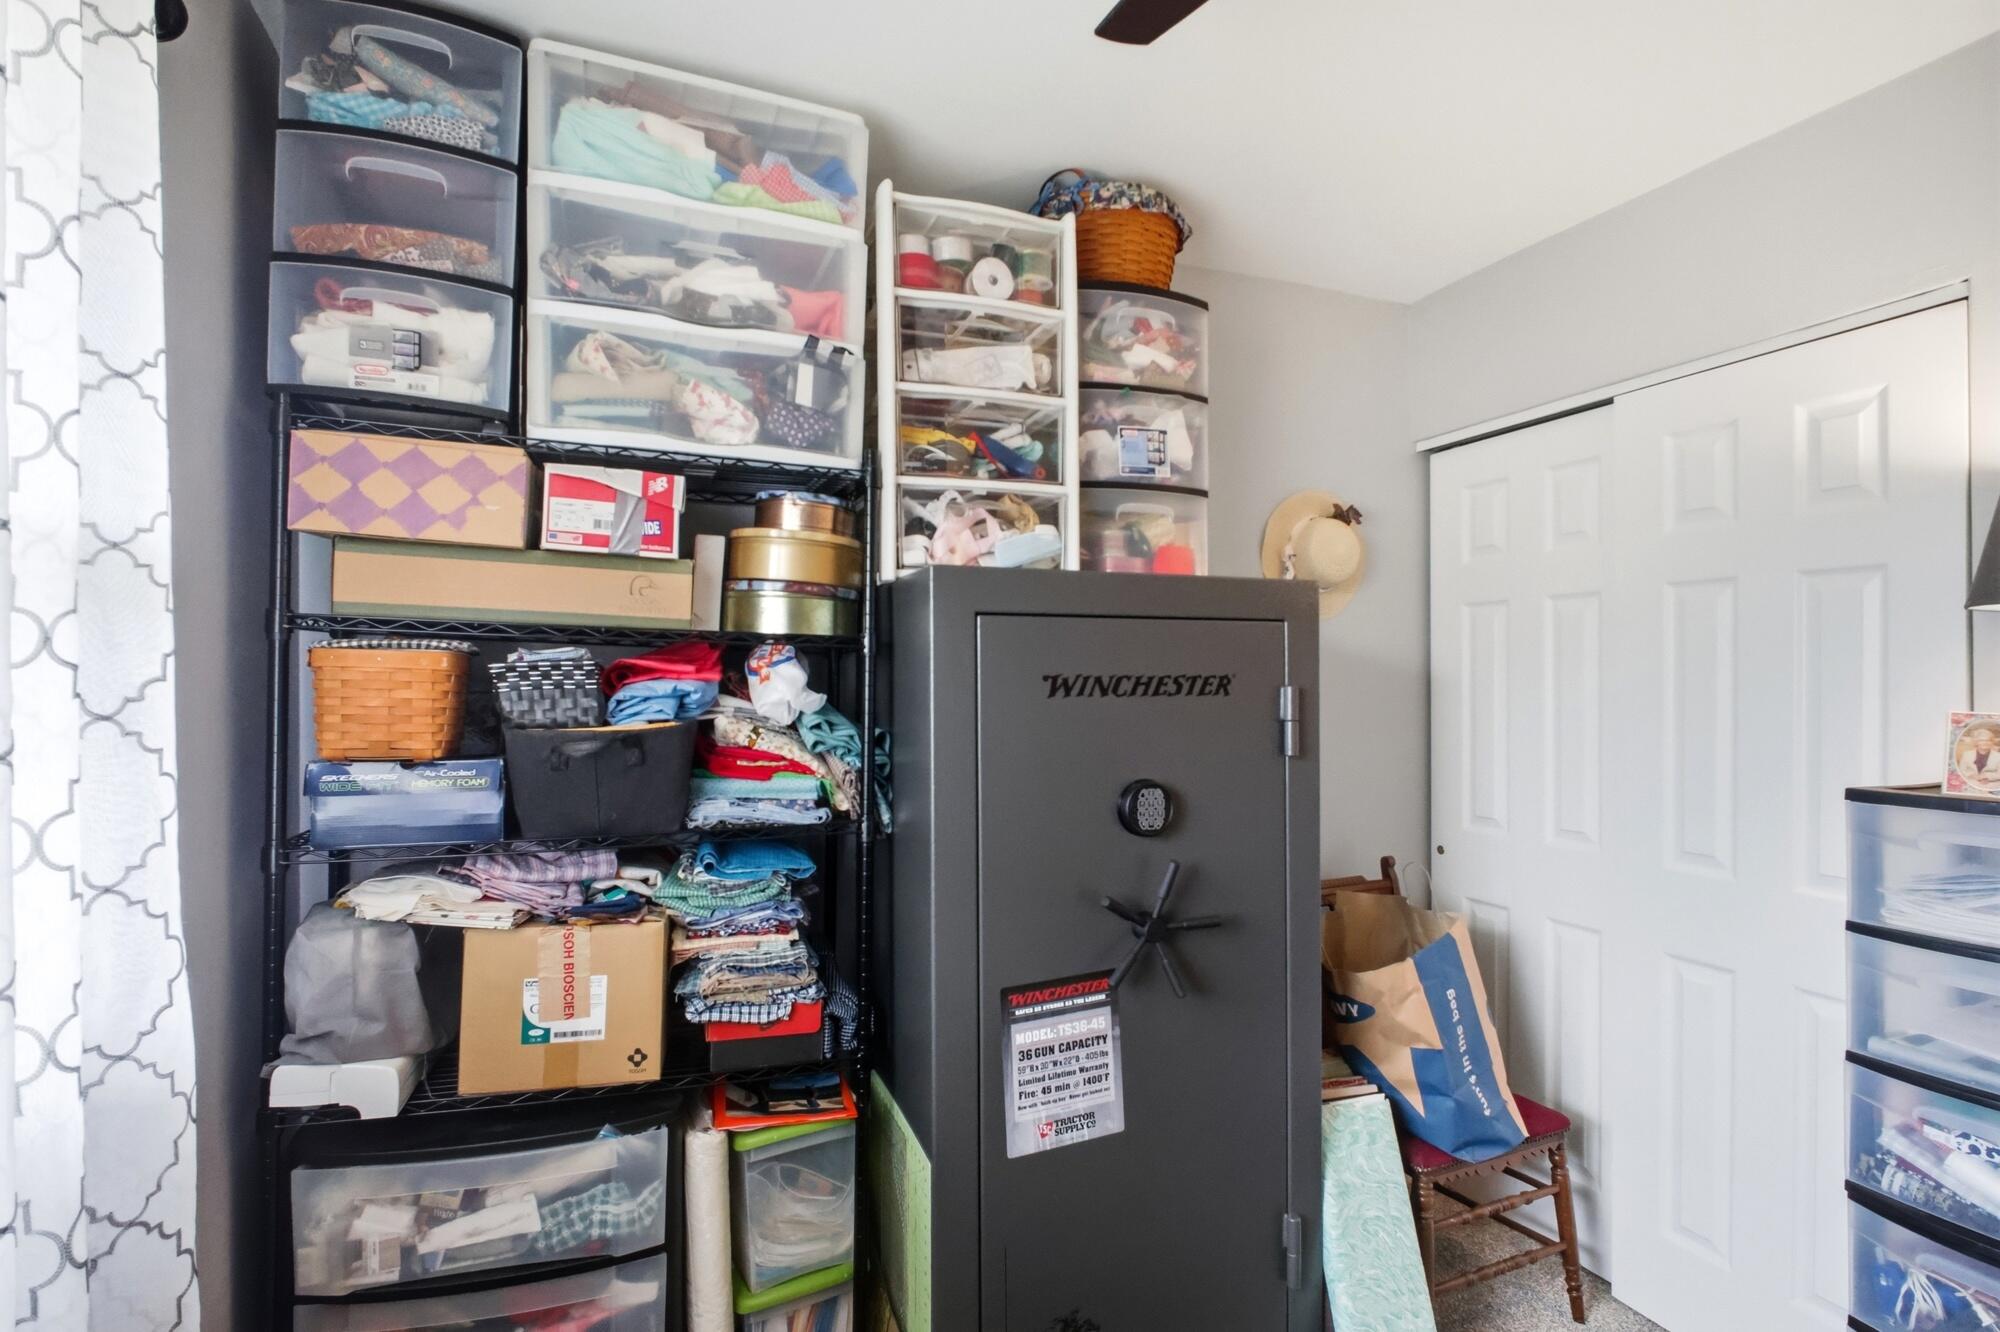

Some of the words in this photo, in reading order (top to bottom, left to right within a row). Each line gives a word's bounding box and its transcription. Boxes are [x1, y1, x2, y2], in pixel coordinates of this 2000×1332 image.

[1042, 674, 1232, 699] WINCHESTER
[319, 774, 400, 782] SKECHERS
[424, 768, 477, 777] Air-Cooled
[319, 782, 362, 792] WIDE
[457, 777, 486, 787] FOAM
[1007, 978, 1110, 1008] WINCHESTER
[1446, 988, 1460, 1022] bag
[1015, 1028, 1057, 1045] MODEL:
[1456, 1025, 1467, 1053] the
[1018, 1049, 1033, 1062] 36
[1034, 1045, 1055, 1058] GUN
[1058, 1034, 1108, 1053] CAPACITY
[1462, 1055, 1473, 1073] in
[1018, 1074, 1046, 1087] Limited
[1048, 1068, 1077, 1081] Lifetime
[1078, 1062, 1109, 1074] Warranty
[1018, 1089, 1039, 1101] Fire:
[1041, 1085, 1052, 1096] 45
[1054, 1082, 1071, 1093] min
[1054, 1112, 1096, 1128] TRACTOR
[1054, 1123, 1086, 1137] SUPPLY
